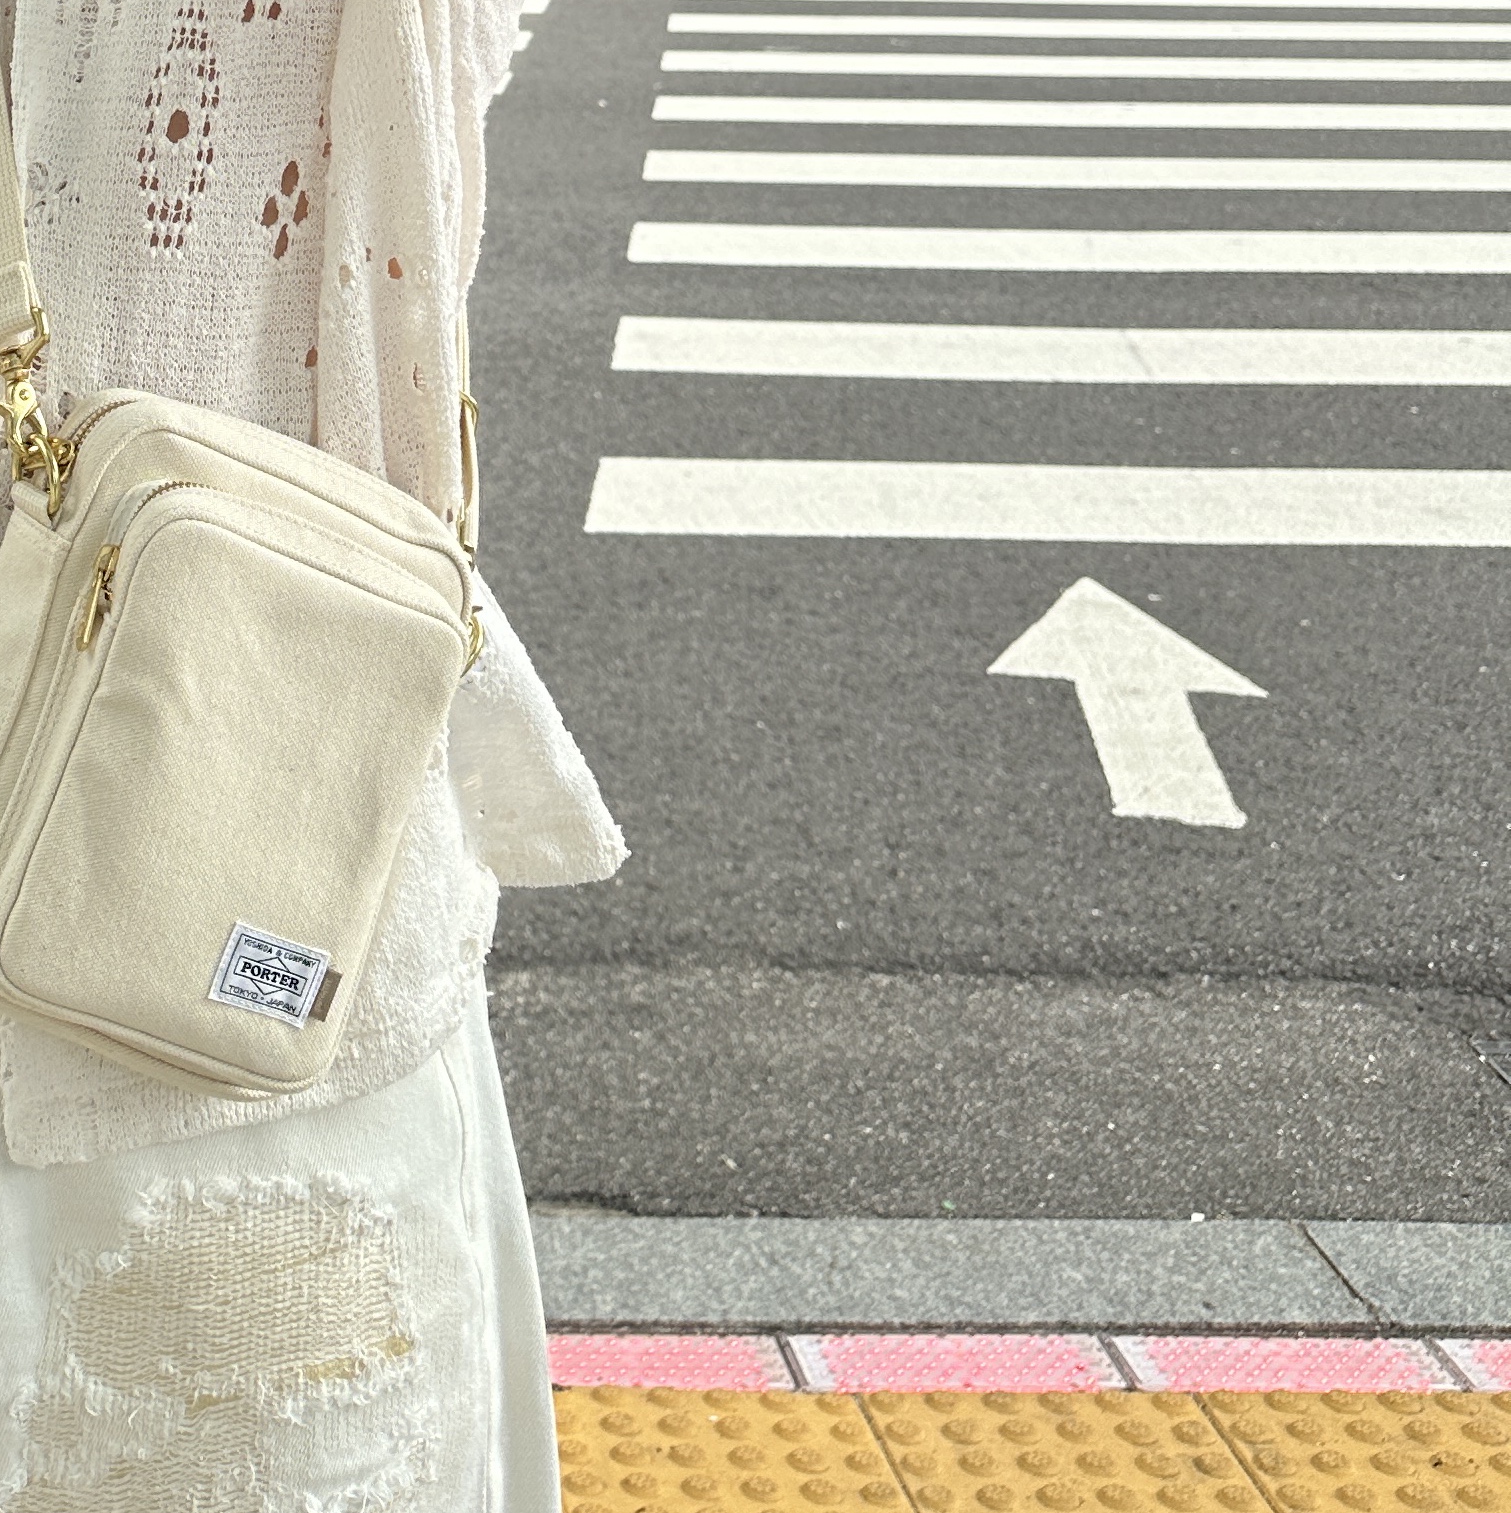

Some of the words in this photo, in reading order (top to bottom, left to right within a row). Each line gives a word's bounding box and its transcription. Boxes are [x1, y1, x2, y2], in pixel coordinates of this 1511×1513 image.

[244, 938, 273, 954] YOSHIDA
[284, 953, 316, 968] COMPANY
[240, 961, 300, 990] PORTER
[229, 985, 259, 999] TOKYO
[266, 999, 296, 1013] JAPAN
